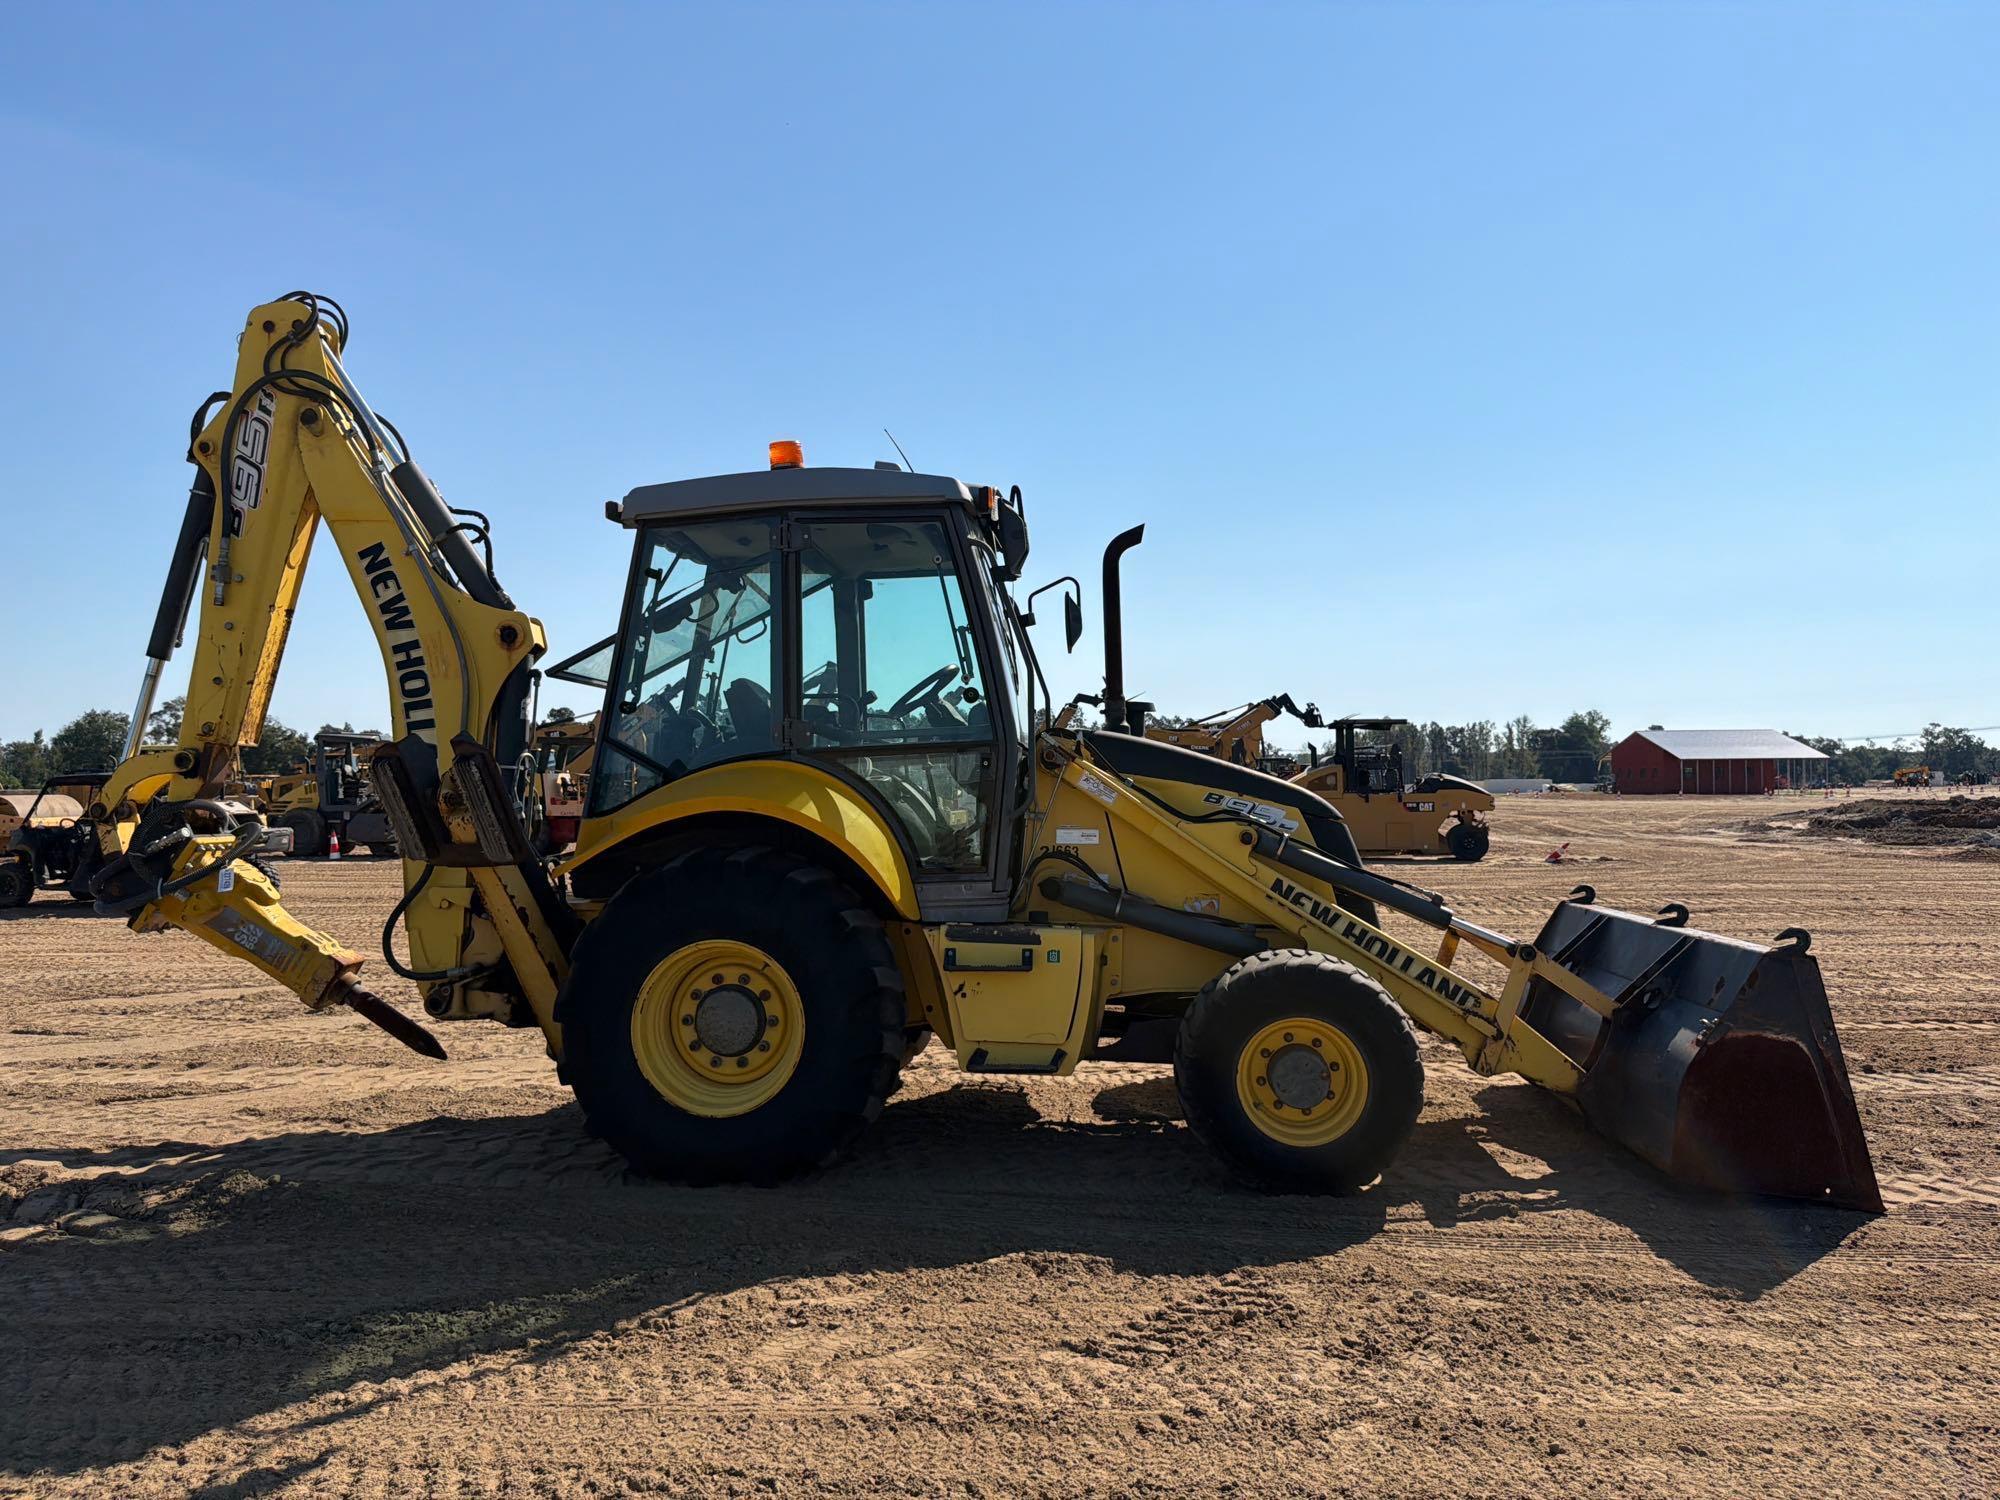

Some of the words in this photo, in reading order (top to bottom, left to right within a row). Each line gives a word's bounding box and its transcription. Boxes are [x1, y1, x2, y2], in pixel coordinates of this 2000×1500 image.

[357, 541, 416, 631] NEW
[1418, 802, 1434, 812] CAT
[1269, 876, 1342, 928] NEW
[1341, 920, 1483, 1010] HOLLAND
